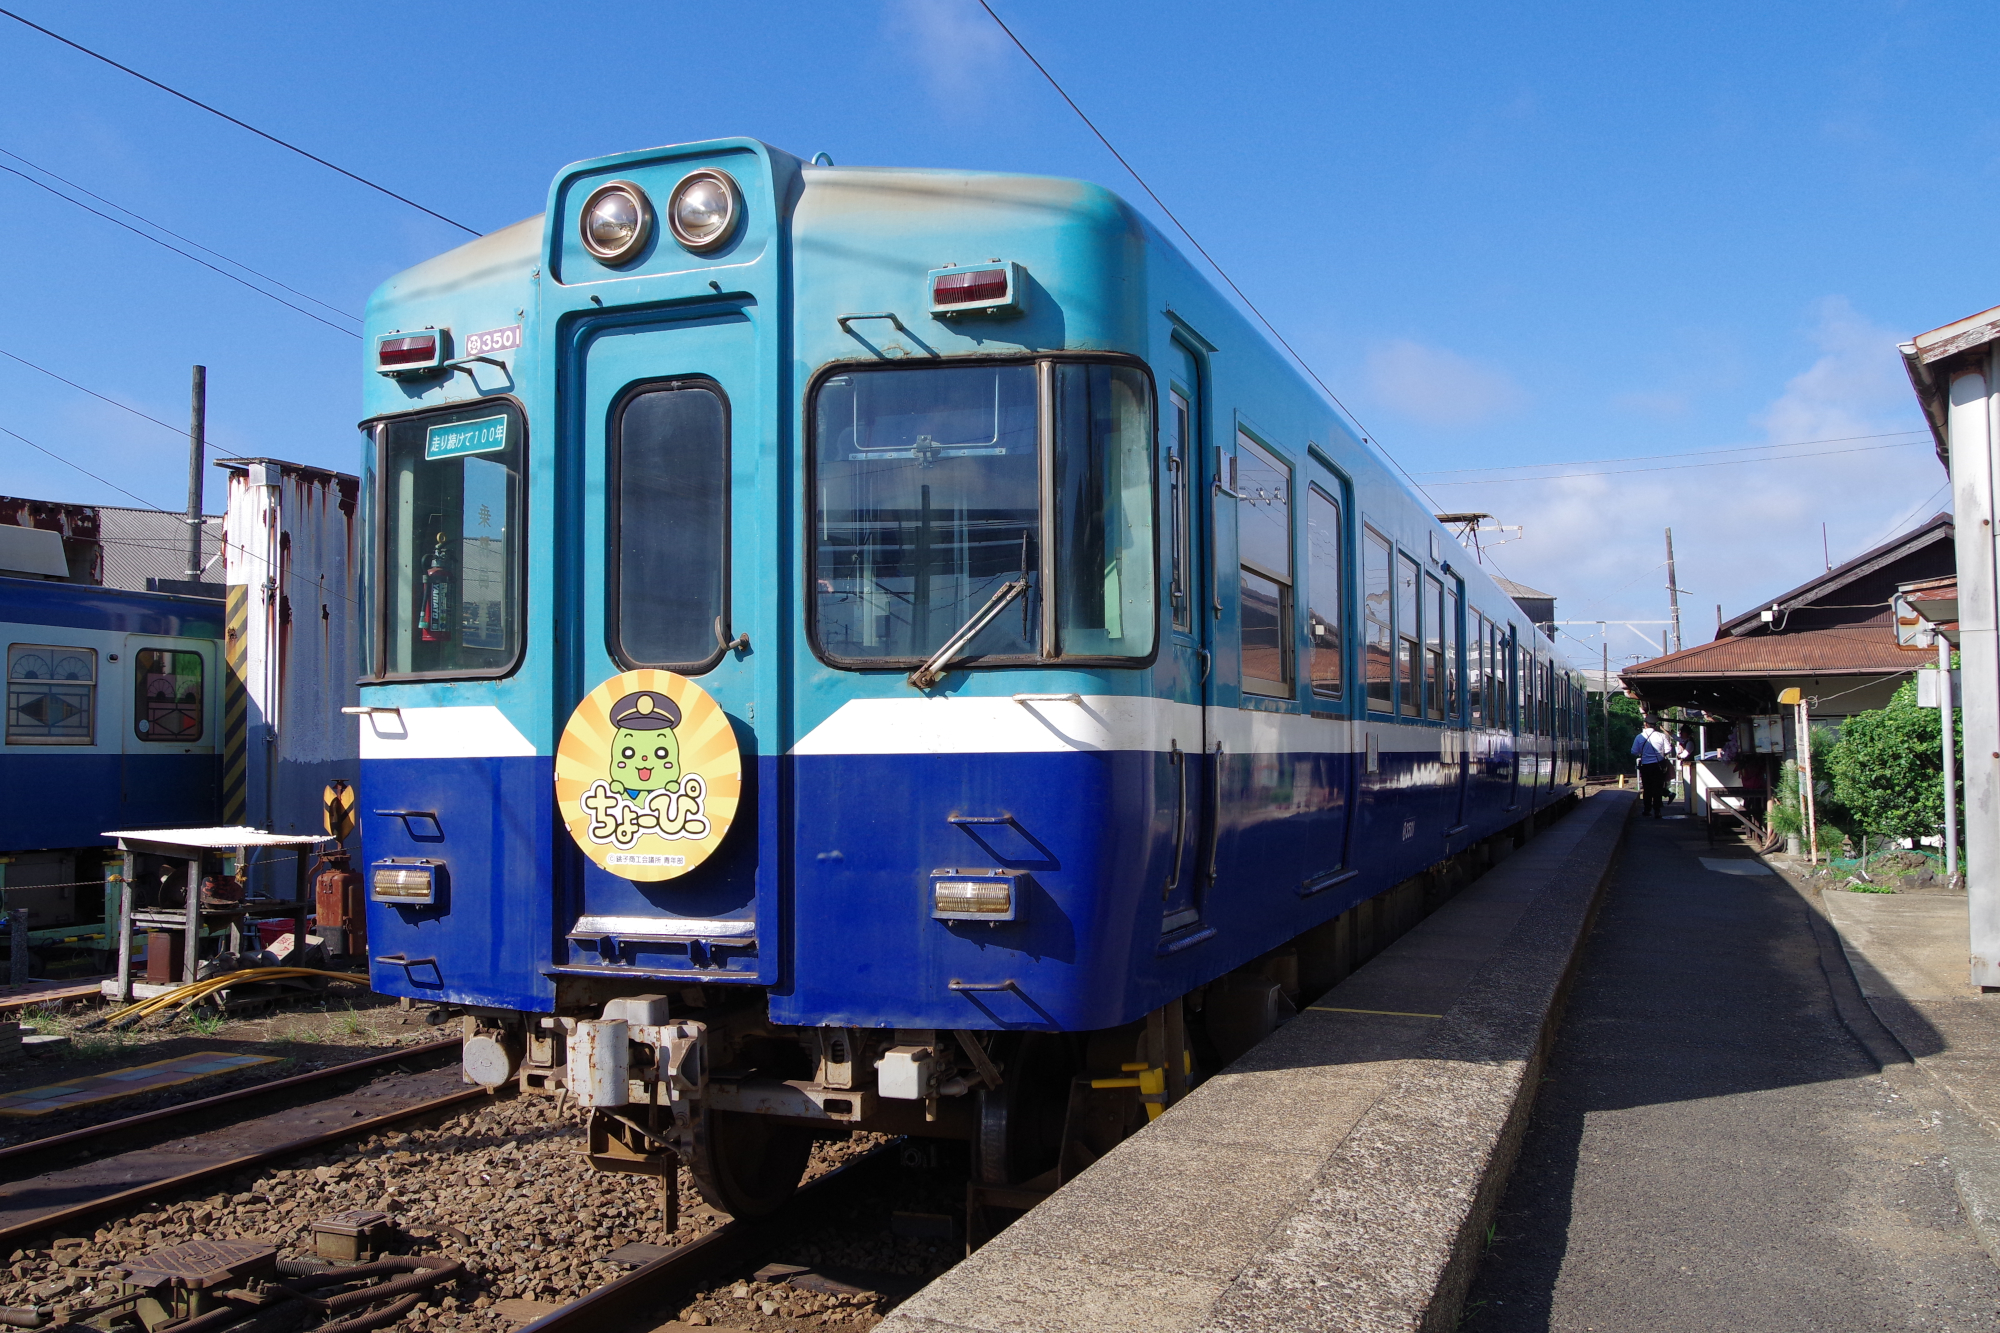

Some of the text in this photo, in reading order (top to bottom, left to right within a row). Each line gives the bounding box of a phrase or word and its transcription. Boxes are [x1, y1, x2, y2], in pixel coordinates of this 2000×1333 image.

[482, 328, 520, 351] 3501
[431, 424, 504, 452] 走り続けて100年
[432, 583, 440, 620] YAMATO
[585, 778, 706, 844] ちょーぴー
